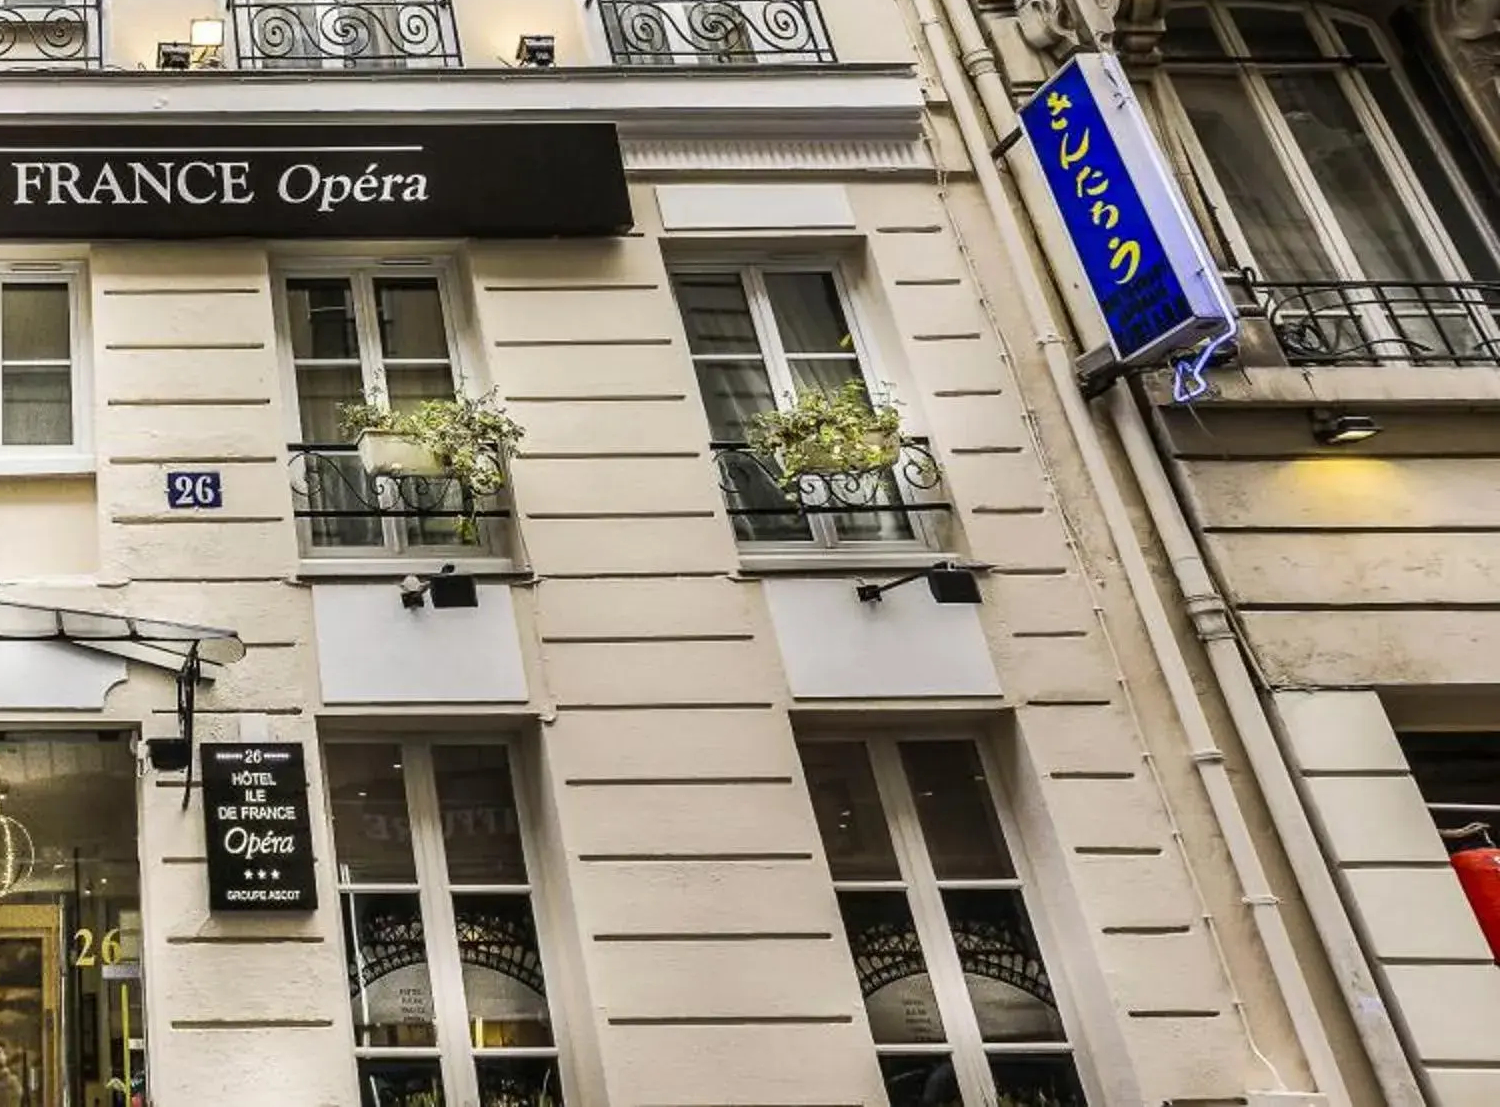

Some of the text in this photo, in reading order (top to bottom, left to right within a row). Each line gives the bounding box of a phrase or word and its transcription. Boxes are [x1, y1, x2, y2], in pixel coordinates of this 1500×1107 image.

[11, 161, 256, 206] FRANCE
[276, 163, 429, 213] Opéra
[175, 475, 215, 505] 26
[243, 748, 263, 764] 26
[231, 769, 277, 786] HÔTEL
[245, 789, 267, 803] ILE
[217, 805, 297, 820] DE FRANCE
[224, 826, 296, 860] Opéra
[227, 890, 301, 901] GROUPE ASCOT
[73, 928, 122, 967] 26
